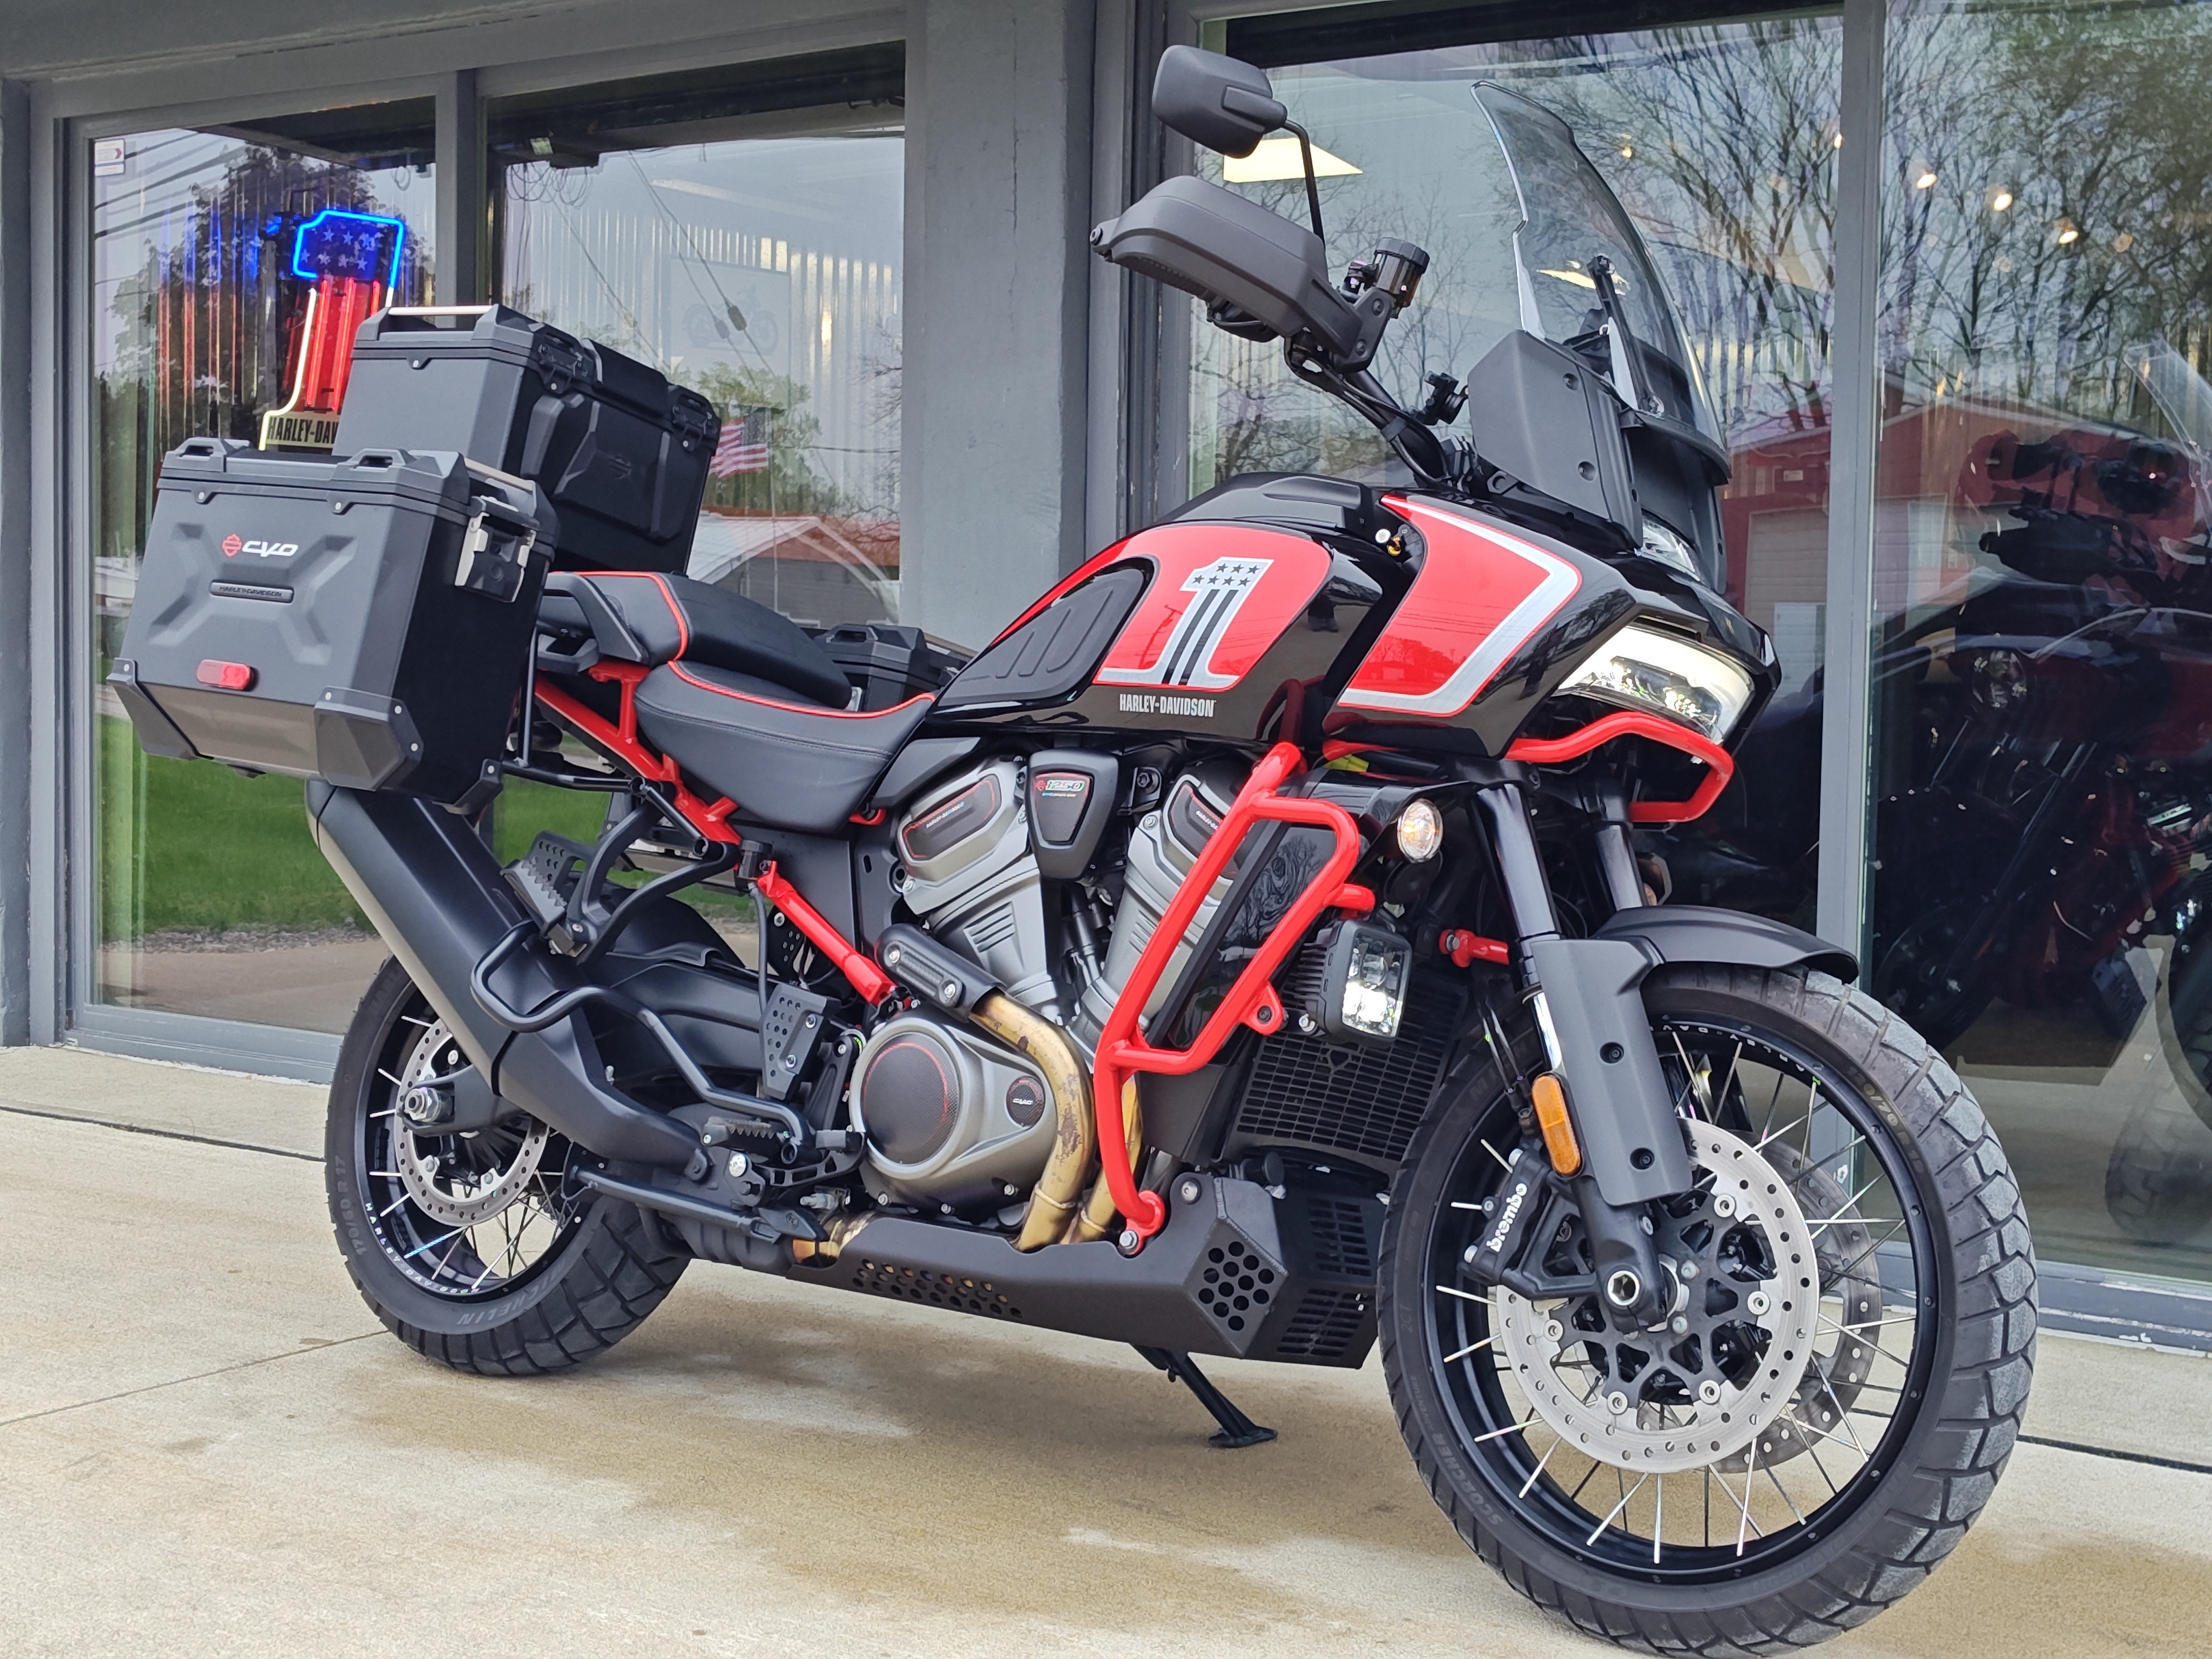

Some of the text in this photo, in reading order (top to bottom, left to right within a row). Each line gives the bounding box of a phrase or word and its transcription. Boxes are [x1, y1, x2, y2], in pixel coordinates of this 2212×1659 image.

[242, 540, 299, 558] CVO
[219, 586, 282, 597] HARLEY-DAVIDSON
[1120, 693, 1215, 718] HARLEY-DAVIDSON
[1486, 1183, 1528, 1252] brembo
[1431, 1432, 1505, 1526] SCORCHER
